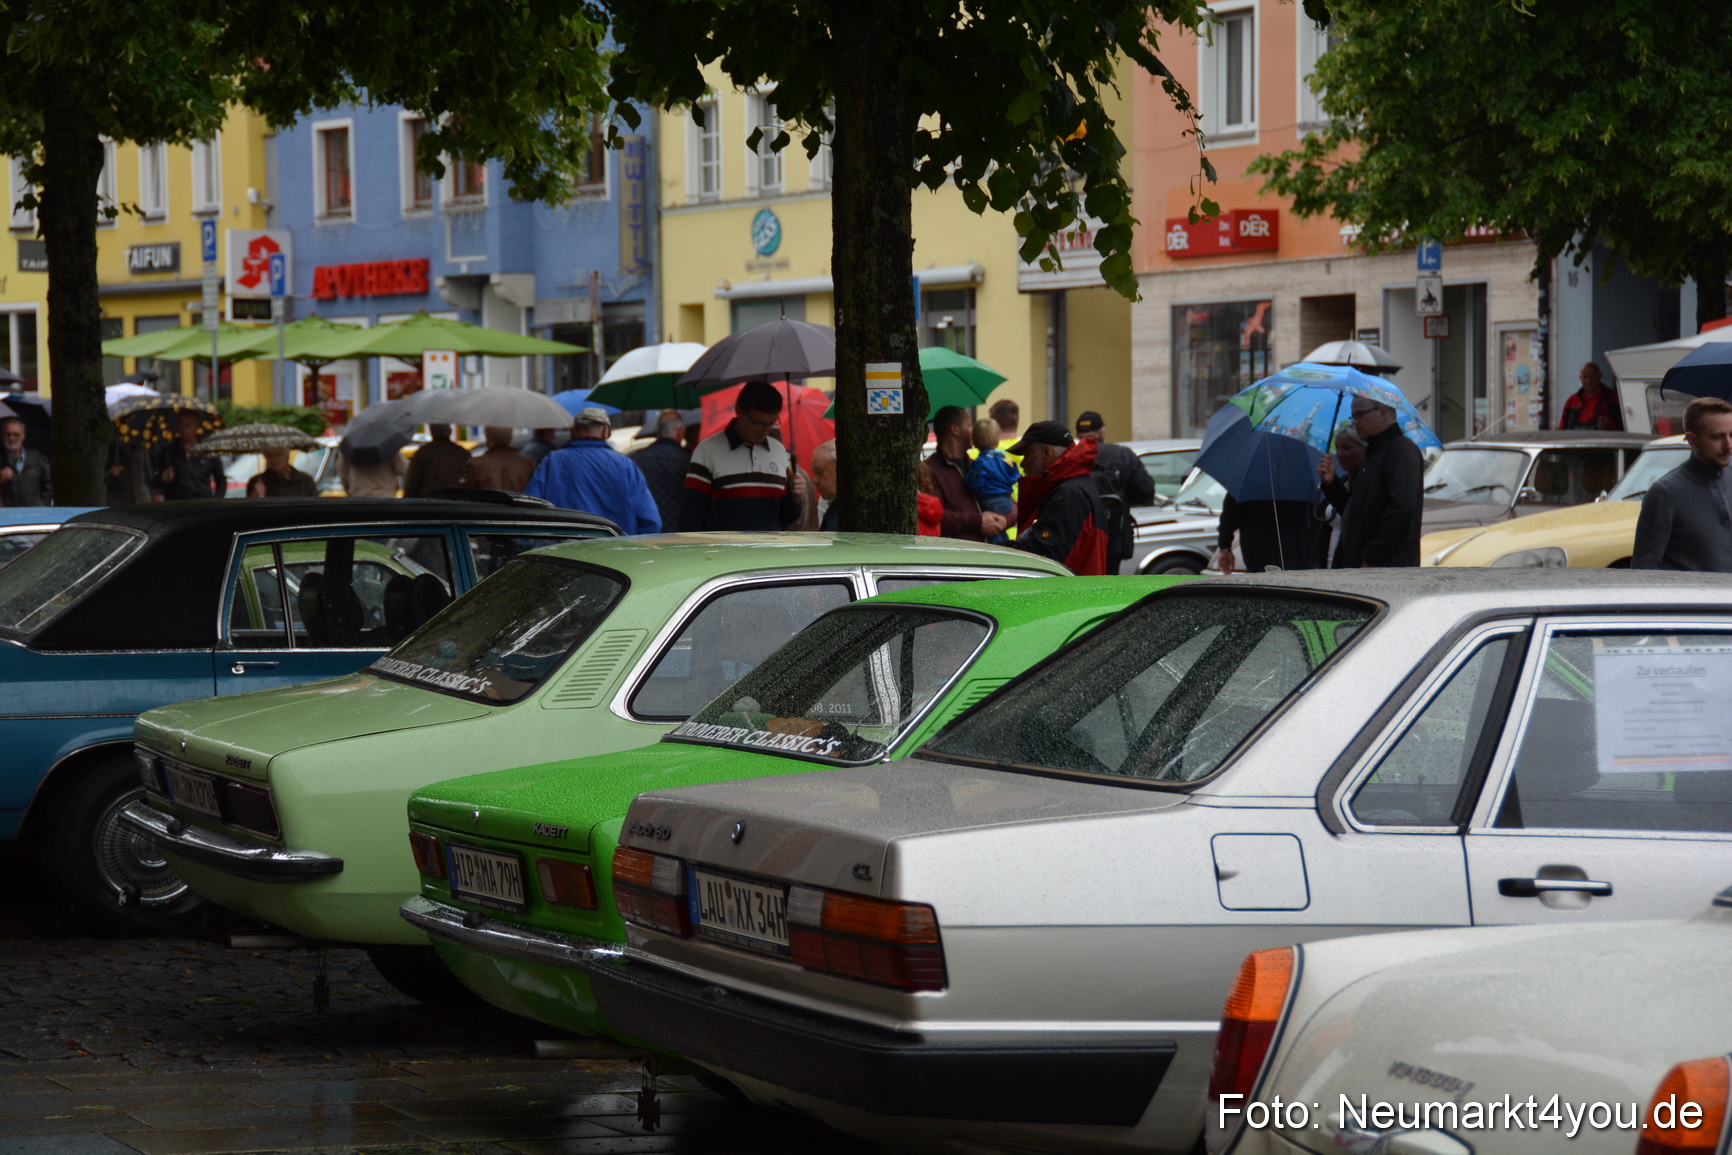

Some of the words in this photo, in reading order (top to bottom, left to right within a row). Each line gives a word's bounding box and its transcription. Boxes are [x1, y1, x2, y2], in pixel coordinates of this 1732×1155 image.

[1167, 225, 1189, 249] DER
[1239, 215, 1270, 236] DER
[21, 259, 49, 269] TAIF
[124, 246, 172, 268] TAIFUN
[310, 258, 430, 299] APOTHEKE
[1637, 666, 1650, 676] Zu
[1653, 665, 1706, 676] verkaufen
[743, 730, 841, 756] CLASSIC'S
[533, 822, 568, 839] KADETT
[453, 851, 474, 888] HIP
[480, 856, 498, 893] MA
[496, 860, 522, 899] 79H
[697, 878, 726, 925] LAU
[733, 886, 755, 932] XX
[755, 891, 788, 940] 34H
